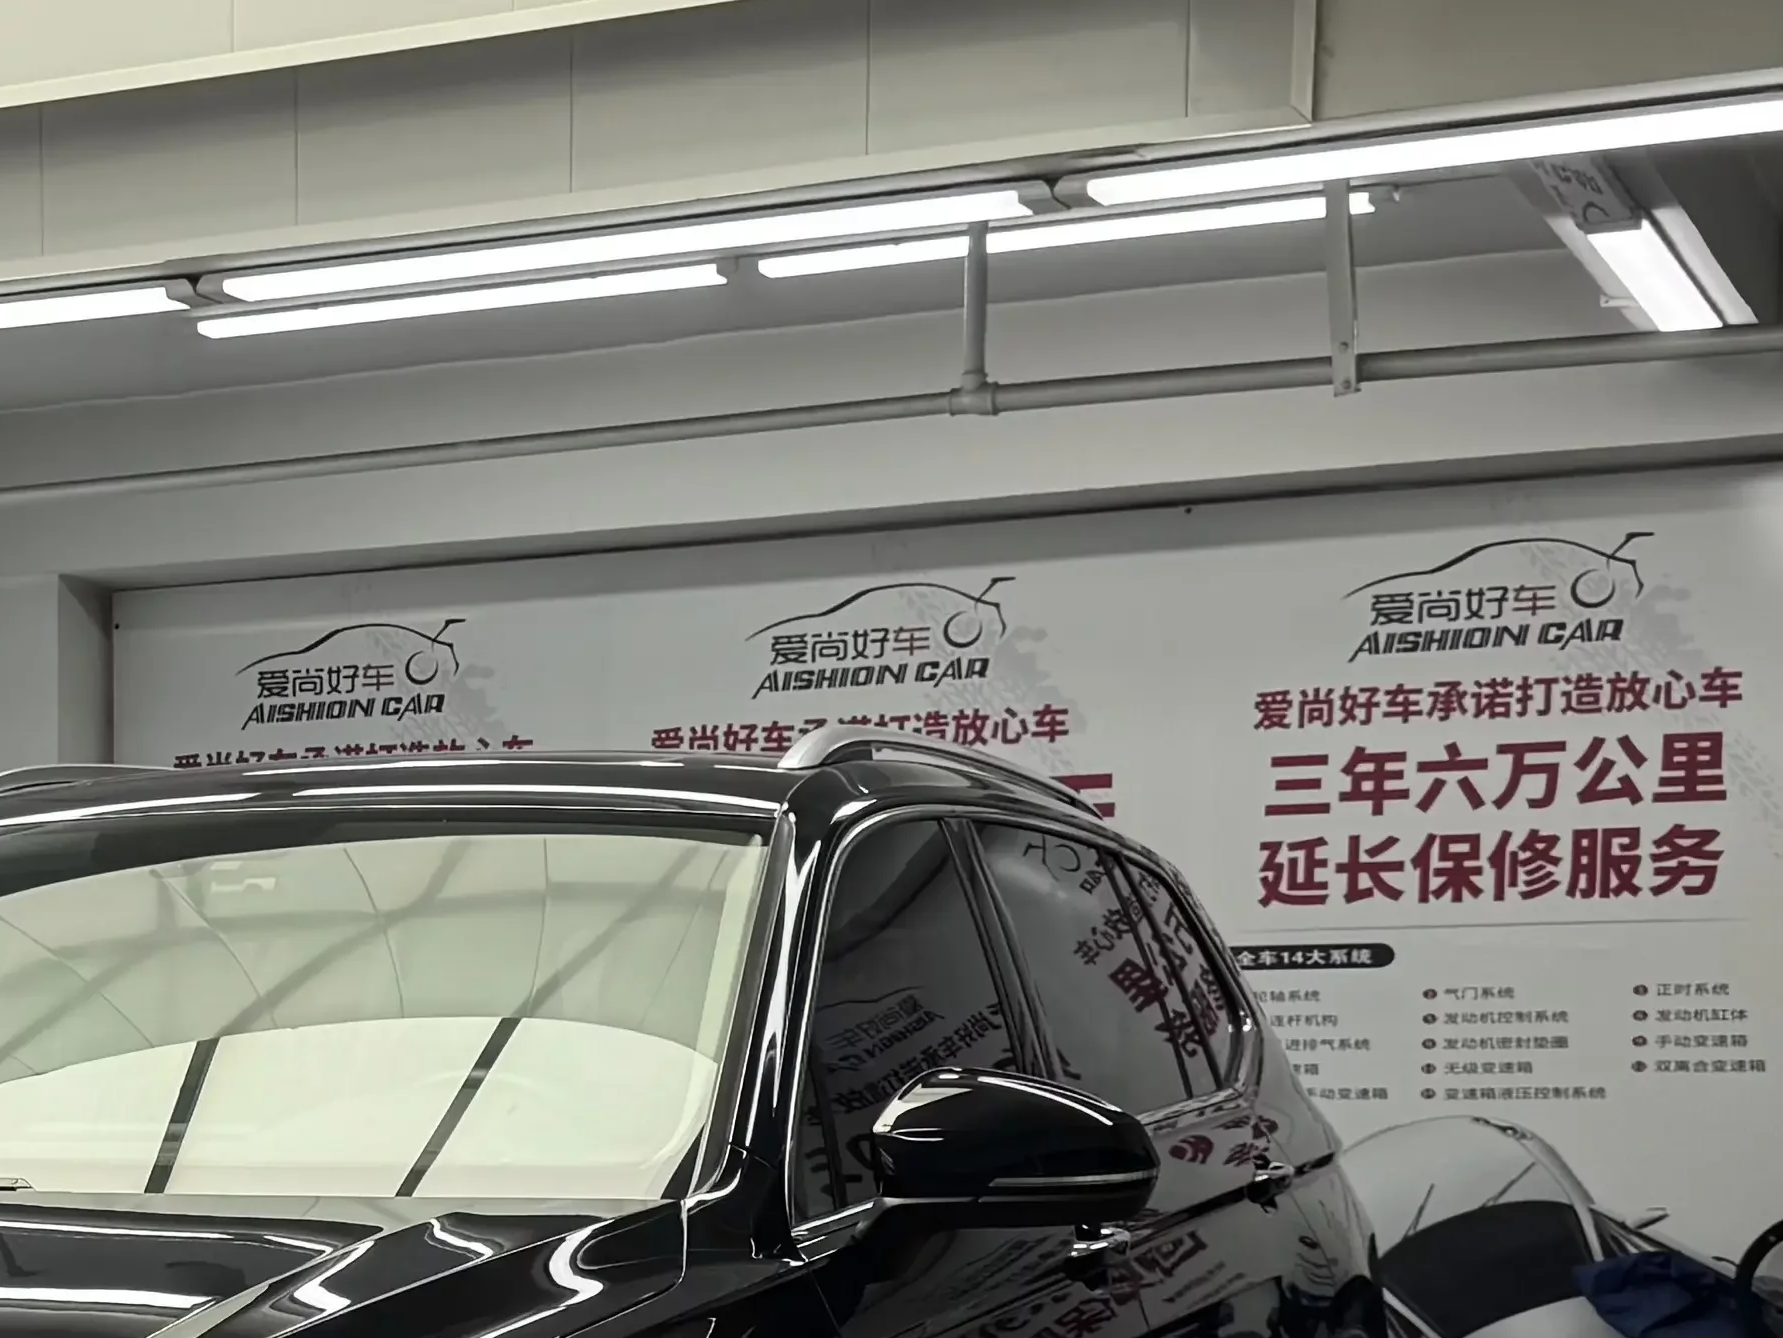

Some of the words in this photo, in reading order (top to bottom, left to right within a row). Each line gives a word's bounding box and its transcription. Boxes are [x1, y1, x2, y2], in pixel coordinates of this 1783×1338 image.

[1369, 584, 1557, 626] 爱尚好车
[769, 626, 931, 666] 爱尚好车
[1347, 624, 1530, 662] AISHION
[1535, 618, 1625, 651] CAR
[257, 664, 395, 699] 爱尚好车
[751, 662, 908, 699] AISHION
[914, 657, 990, 689] CAR
[241, 698, 375, 730] AISHION
[381, 693, 446, 721] CAR
[1253, 666, 1744, 730] 爱尚好车承诺打造放心车
[1263, 731, 1728, 817] 三年六万公里
[1258, 823, 1725, 908] 延长保修服务
[1443, 986, 1515, 1001] 气门系统
[1656, 982, 1730, 997] 正时系统
[1442, 1010, 1570, 1026] 发动机控制系统
[1654, 1008, 1749, 1023] 发动机缸体
[1654, 1034, 1749, 1049] 手动变速箱
[1653, 1058, 1767, 1074] 双离合变速箱
